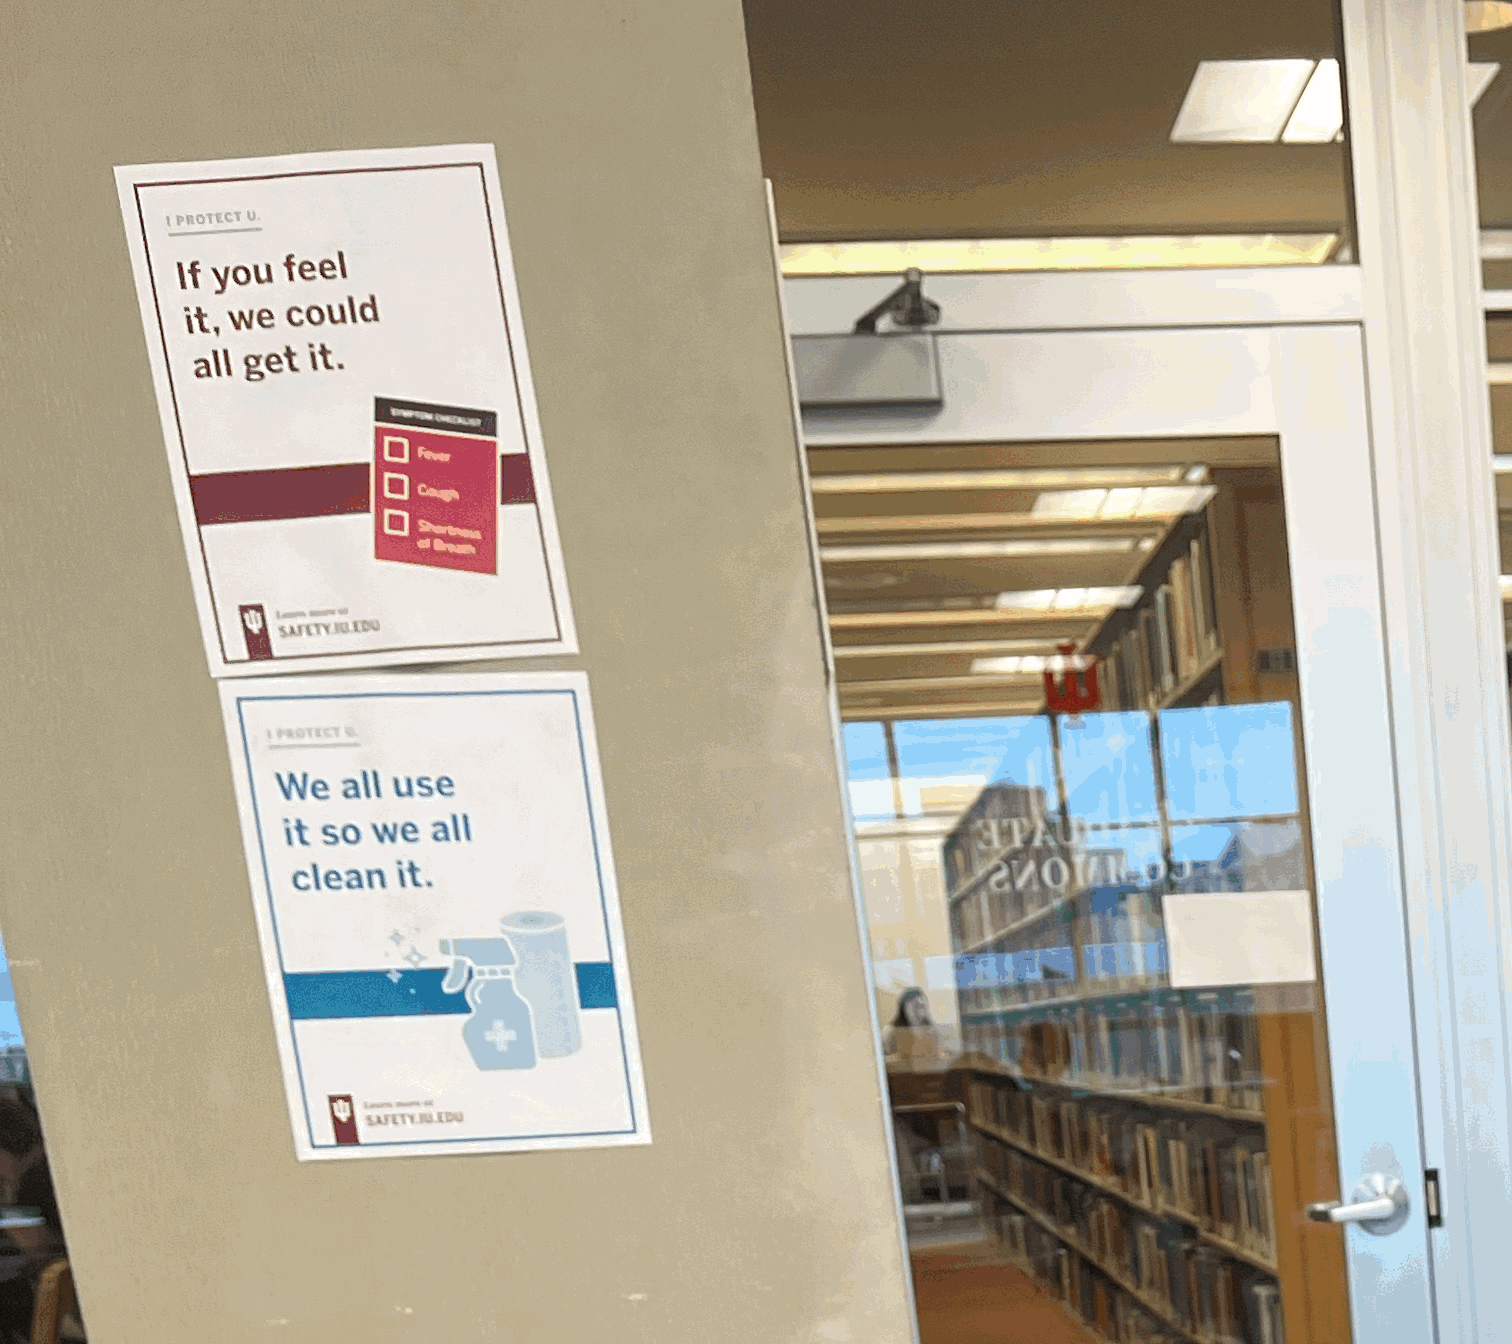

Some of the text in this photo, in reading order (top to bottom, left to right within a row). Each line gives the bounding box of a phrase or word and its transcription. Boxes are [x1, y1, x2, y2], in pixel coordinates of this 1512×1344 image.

[176, 211, 242, 226] PROTECT
[176, 250, 348, 295] If you feel
[183, 294, 380, 337] it, we could
[193, 342, 345, 382] all get it.
[274, 770, 455, 801] We all use
[283, 813, 472, 847] it so we all
[292, 859, 434, 892] clean it.
